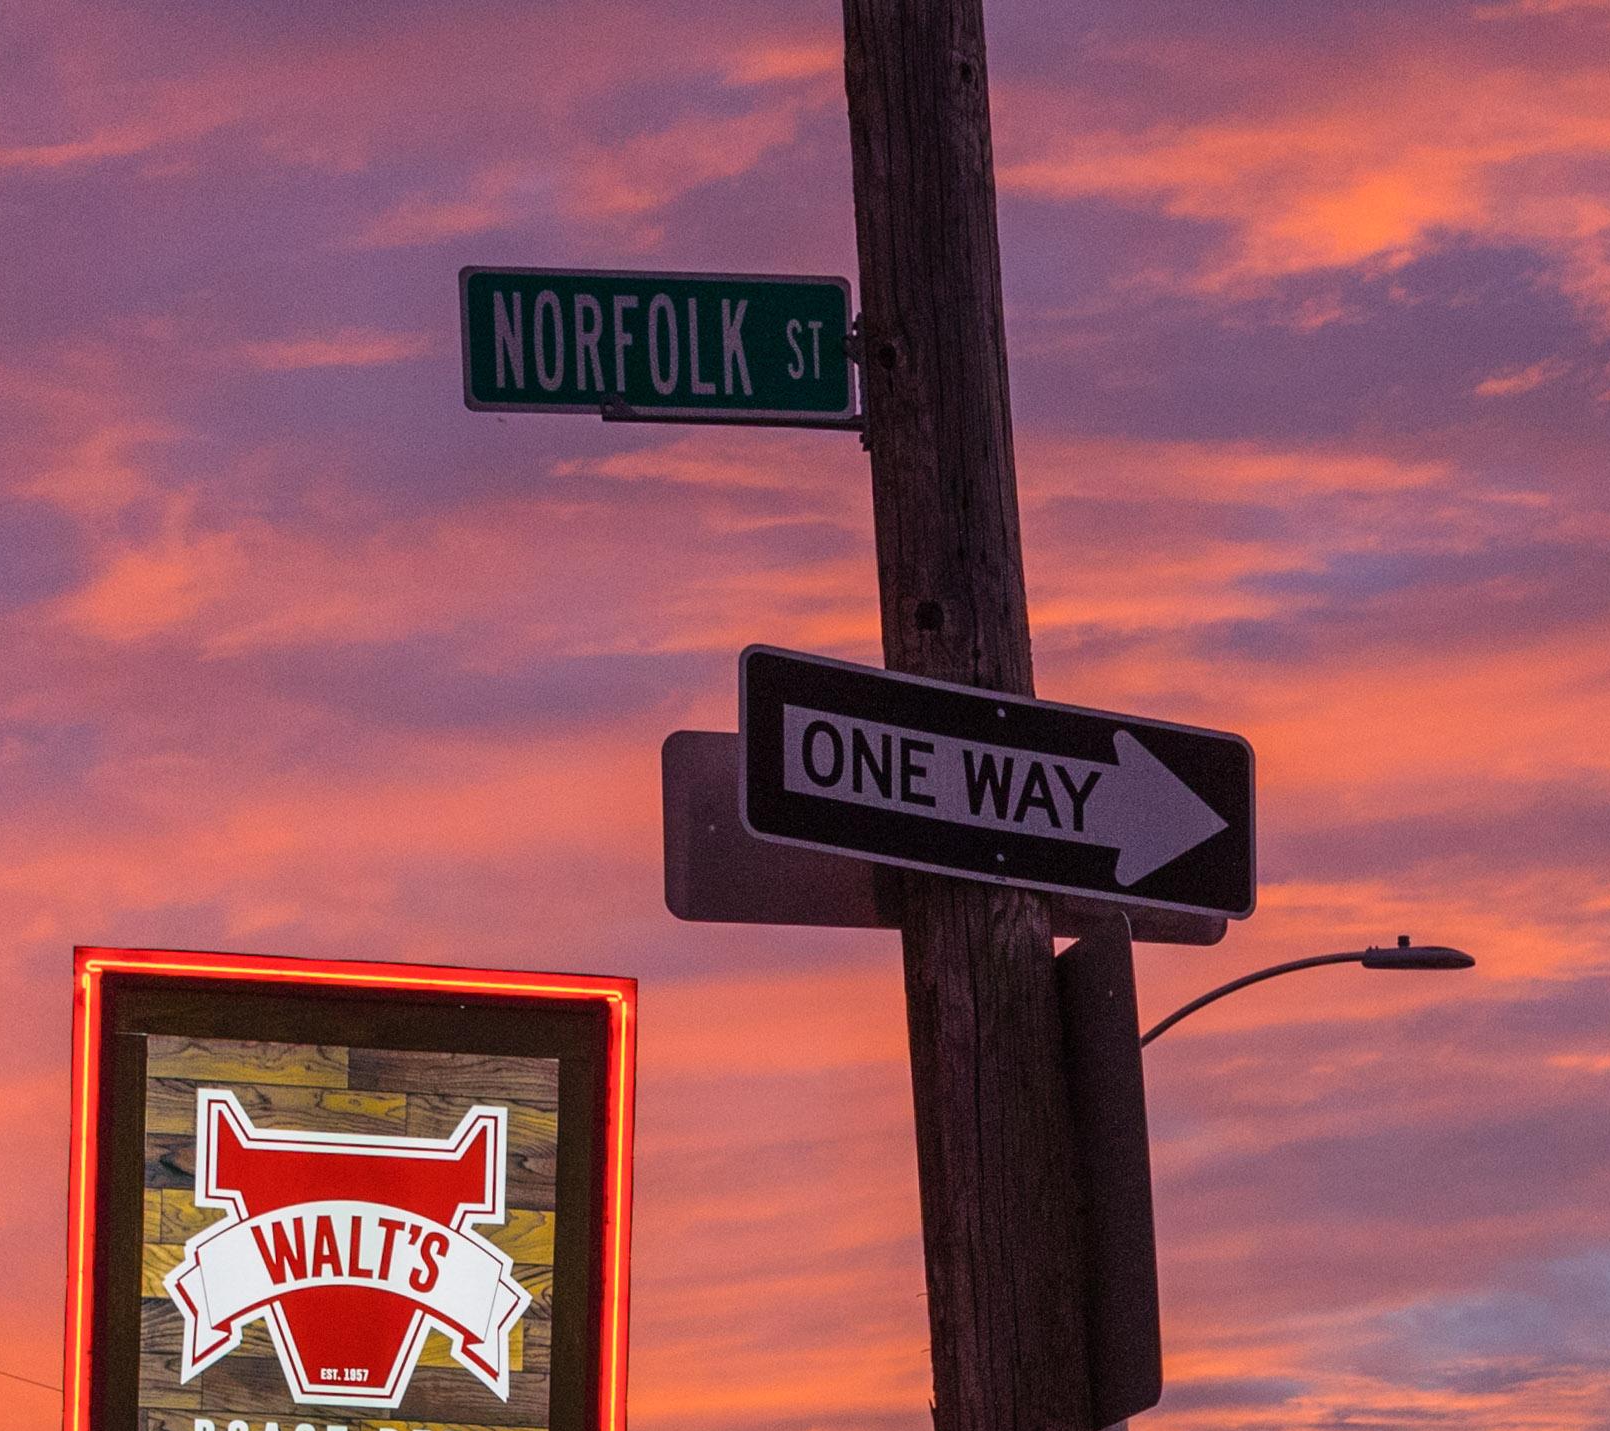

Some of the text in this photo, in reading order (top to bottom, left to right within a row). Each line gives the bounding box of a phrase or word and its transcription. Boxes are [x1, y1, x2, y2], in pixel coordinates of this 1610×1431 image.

[492, 290, 823, 397] NORFOLK ST
[800, 720, 1103, 833] ONE WAY
[251, 1215, 449, 1293] WALT'S
[320, 1368, 341, 1381] EST.
